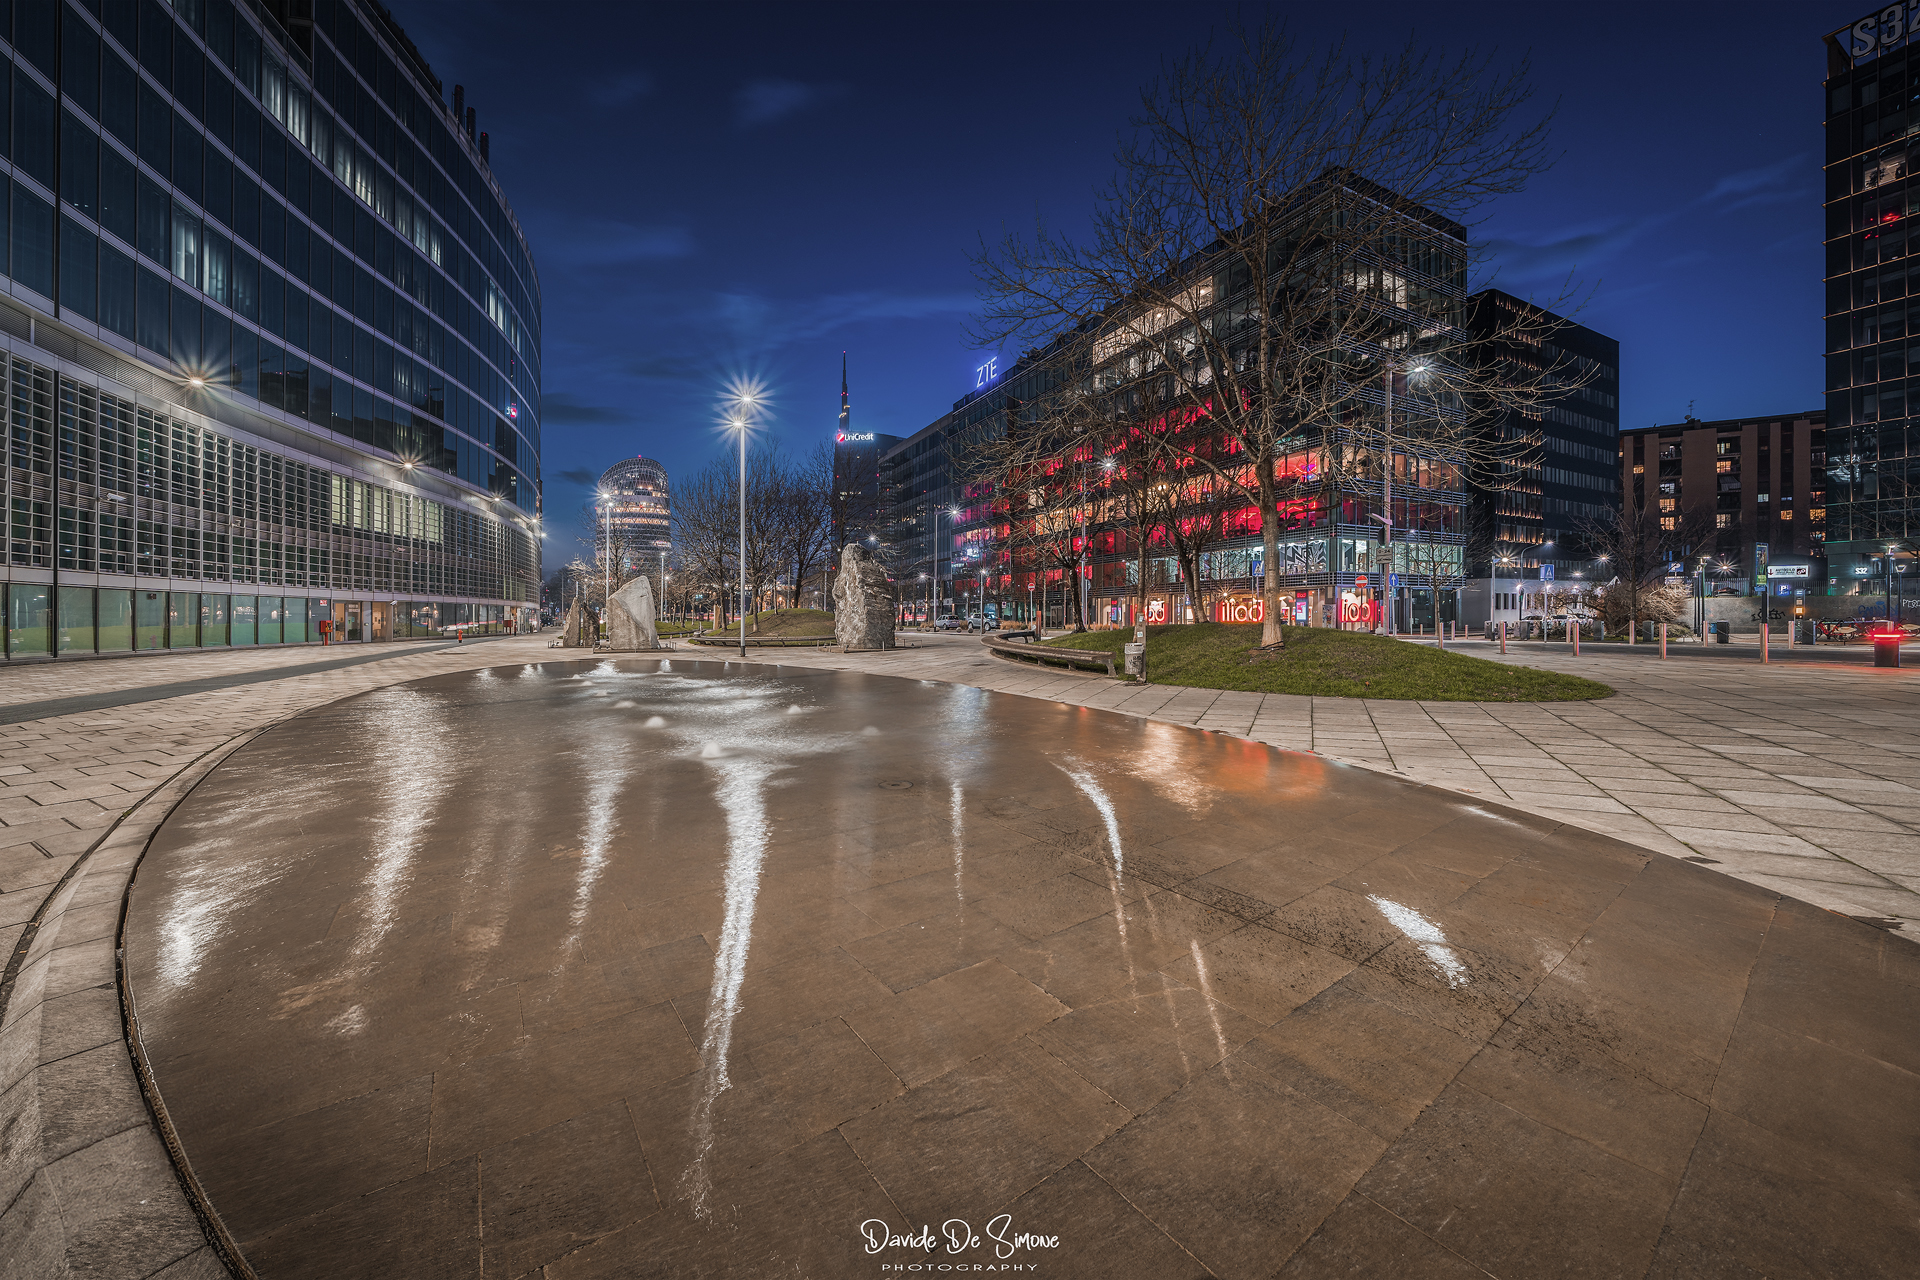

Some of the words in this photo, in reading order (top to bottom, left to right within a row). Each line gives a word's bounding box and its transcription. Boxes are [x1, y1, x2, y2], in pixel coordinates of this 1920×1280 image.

[976, 356, 998, 388] ZTE
[844, 432, 874, 441] UniCredit
[1855, 567, 1868, 575] S32
[1221, 600, 1264, 622] iliad
